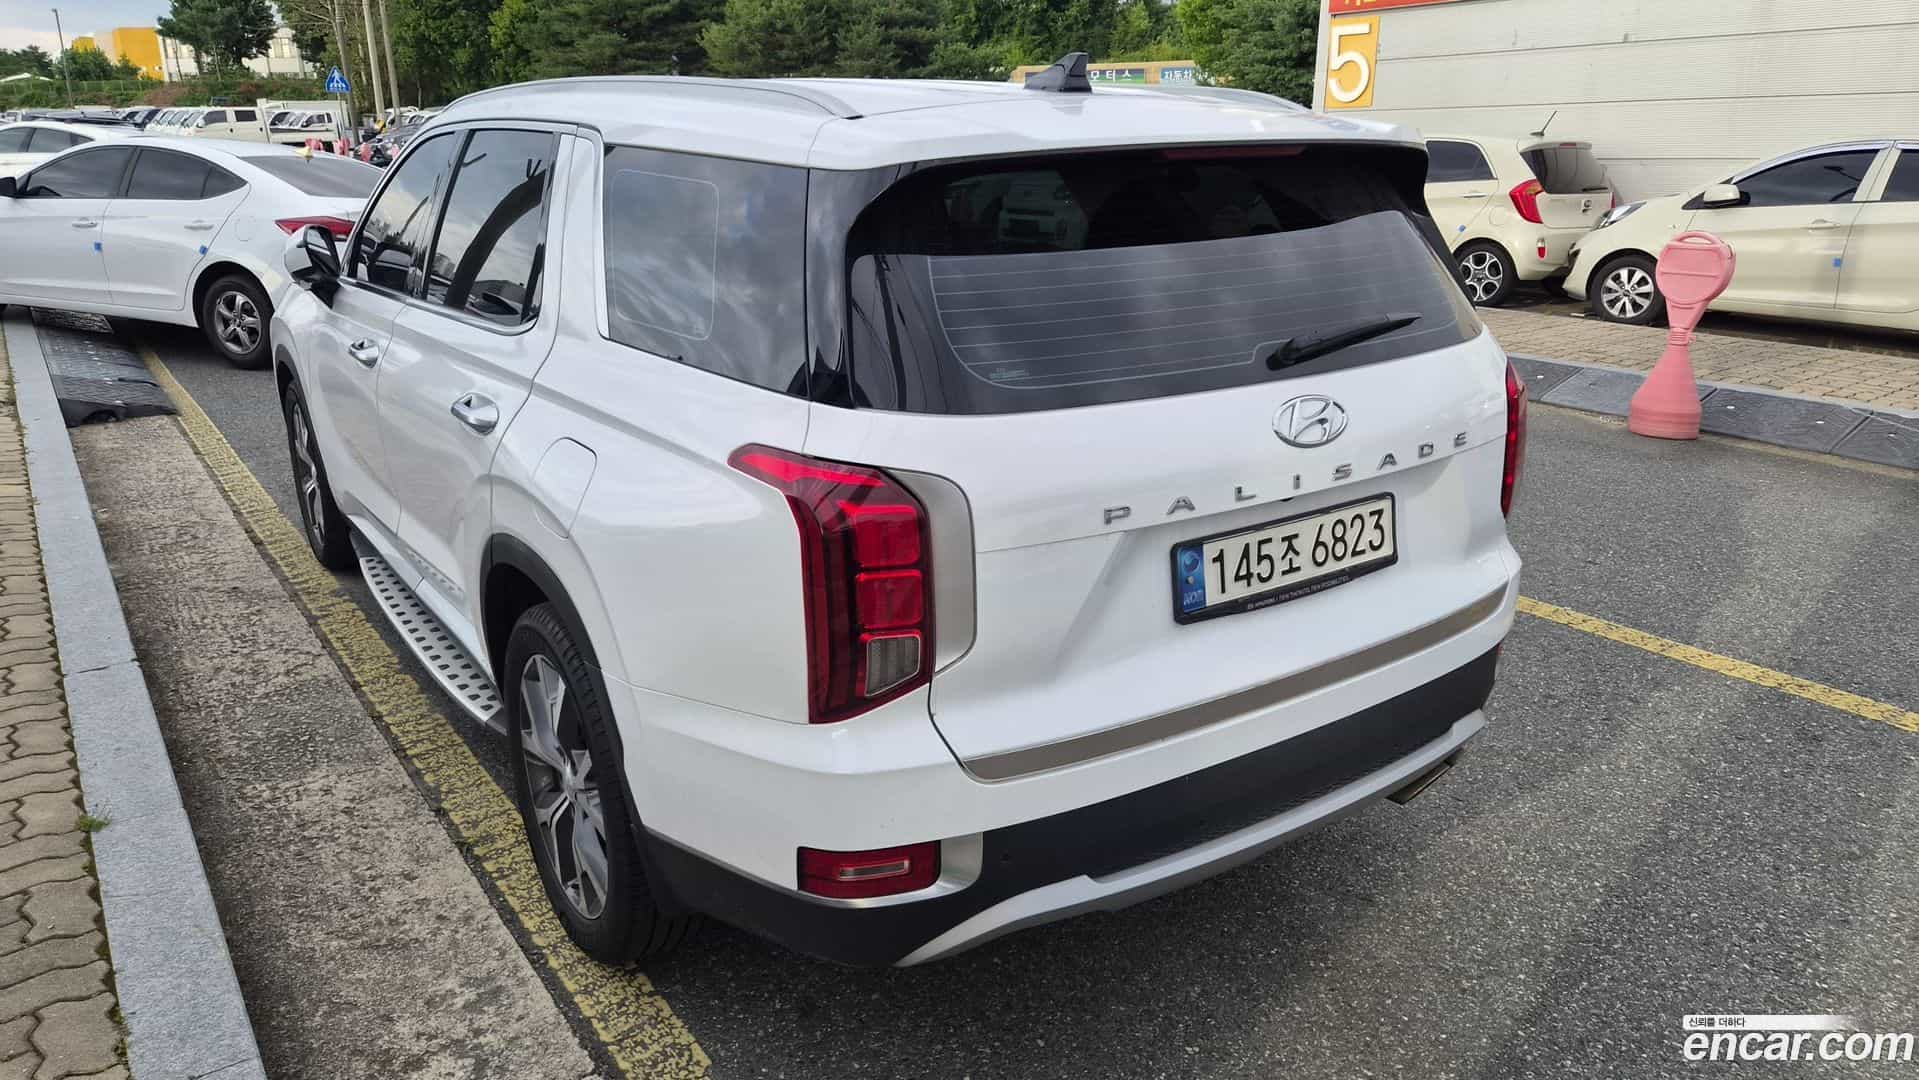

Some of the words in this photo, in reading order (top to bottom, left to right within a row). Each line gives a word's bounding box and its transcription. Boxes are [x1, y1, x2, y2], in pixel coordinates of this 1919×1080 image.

[1090, 69, 1132, 83] 모터스
[1328, 23, 1371, 104] 5
[1103, 431, 1468, 526] PALISADE
[1211, 533, 1302, 594] 145조
[1311, 508, 1386, 569] 6823
